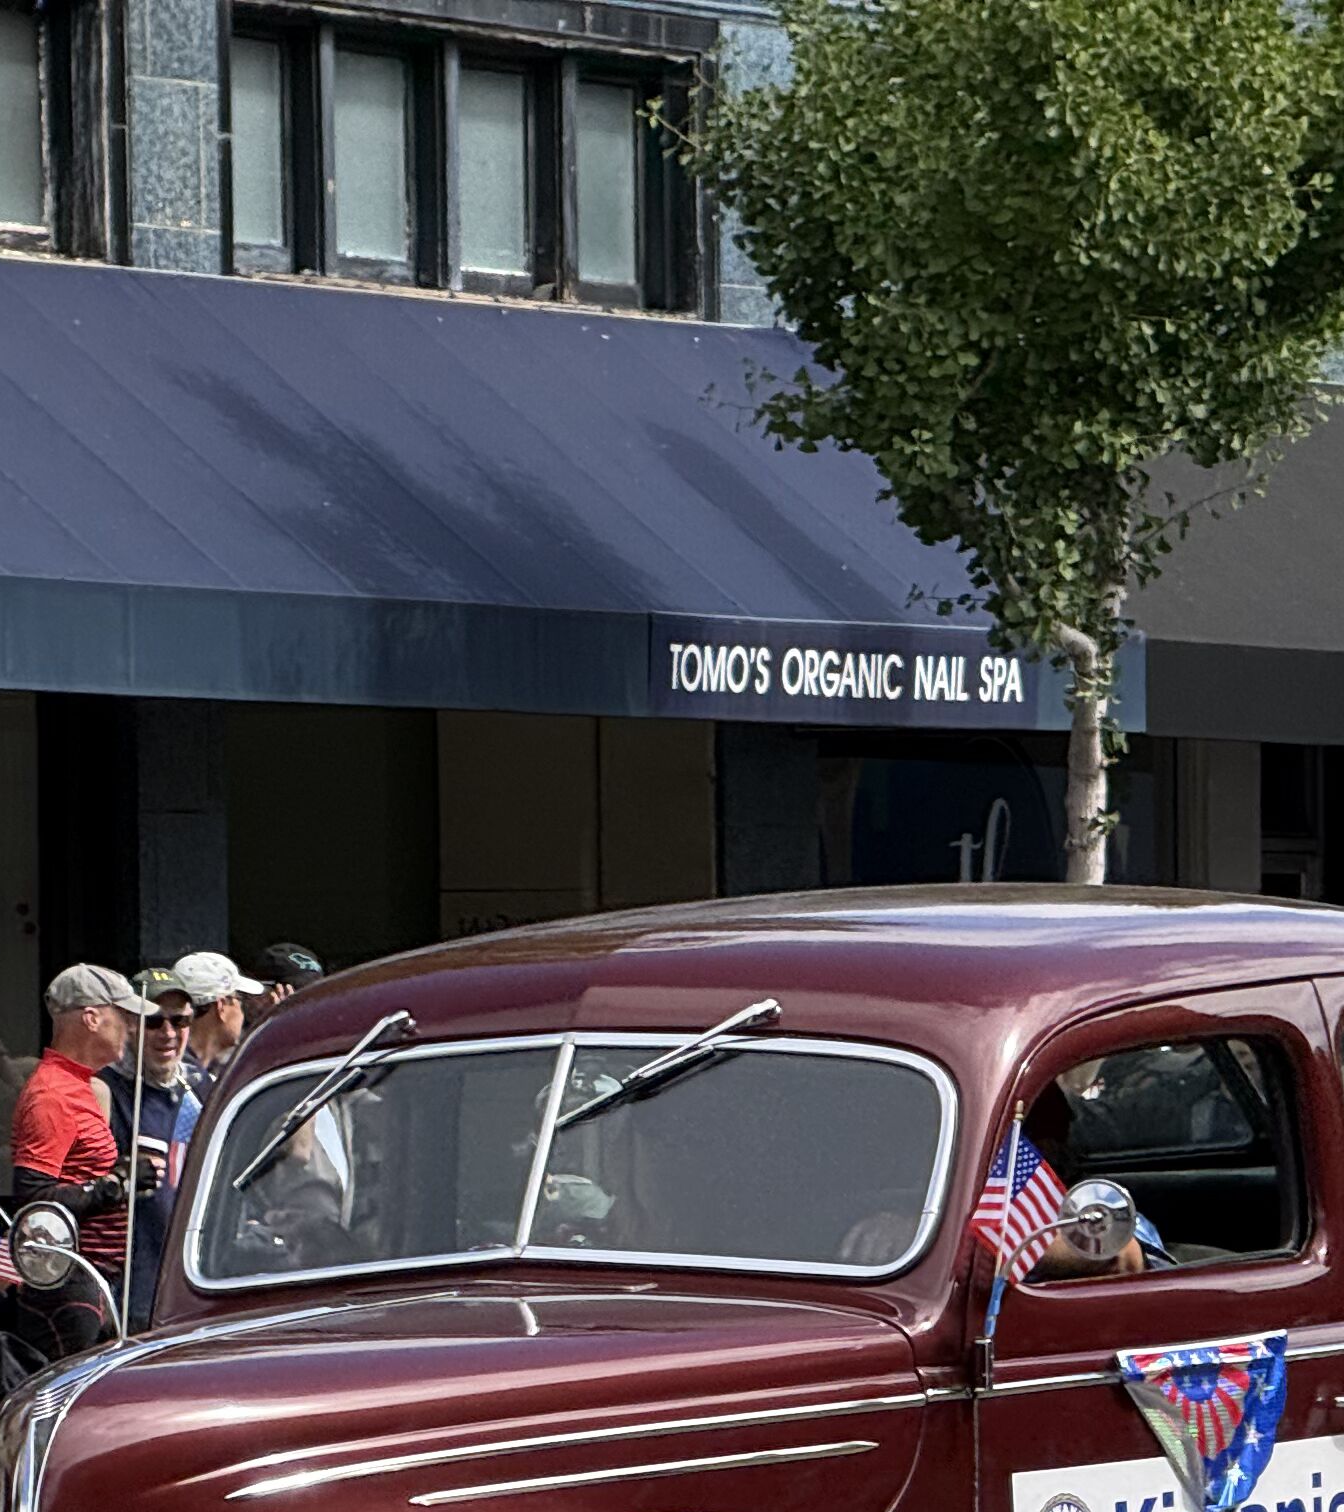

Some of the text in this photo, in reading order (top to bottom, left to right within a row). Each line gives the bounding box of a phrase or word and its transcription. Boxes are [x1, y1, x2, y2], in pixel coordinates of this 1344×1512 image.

[669, 643, 1024, 703] TOMO'S ORGANIC NAIL SPA
